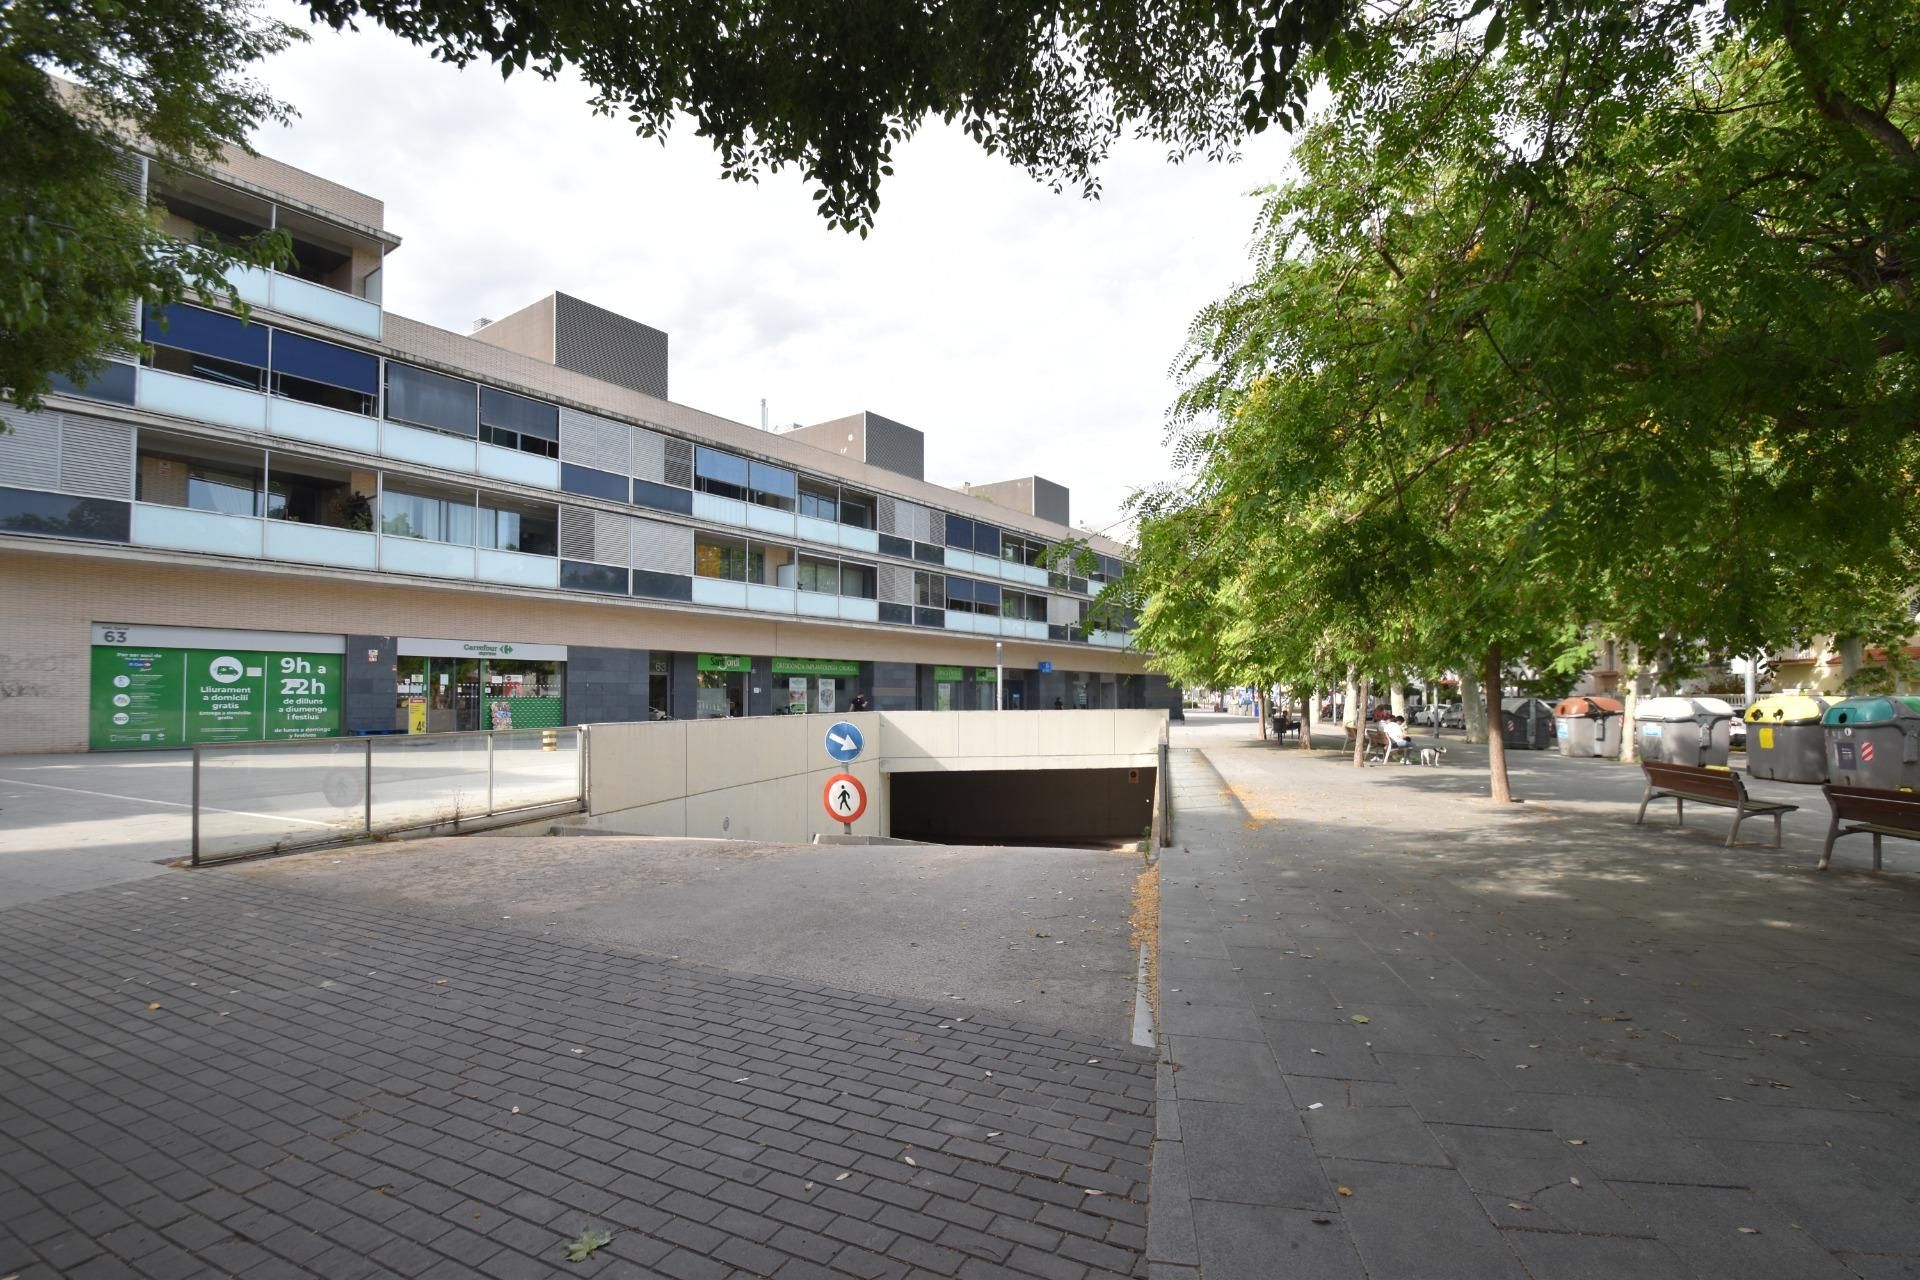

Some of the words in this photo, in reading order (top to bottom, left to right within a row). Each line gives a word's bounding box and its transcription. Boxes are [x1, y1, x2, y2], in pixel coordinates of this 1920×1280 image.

[104, 631, 127, 643] 63
[464, 644, 498, 652] Carrefour
[280, 656, 310, 674] 9h
[318, 665, 326, 674] a
[280, 678, 326, 695] 22h
[212, 702, 240, 710] gratis
